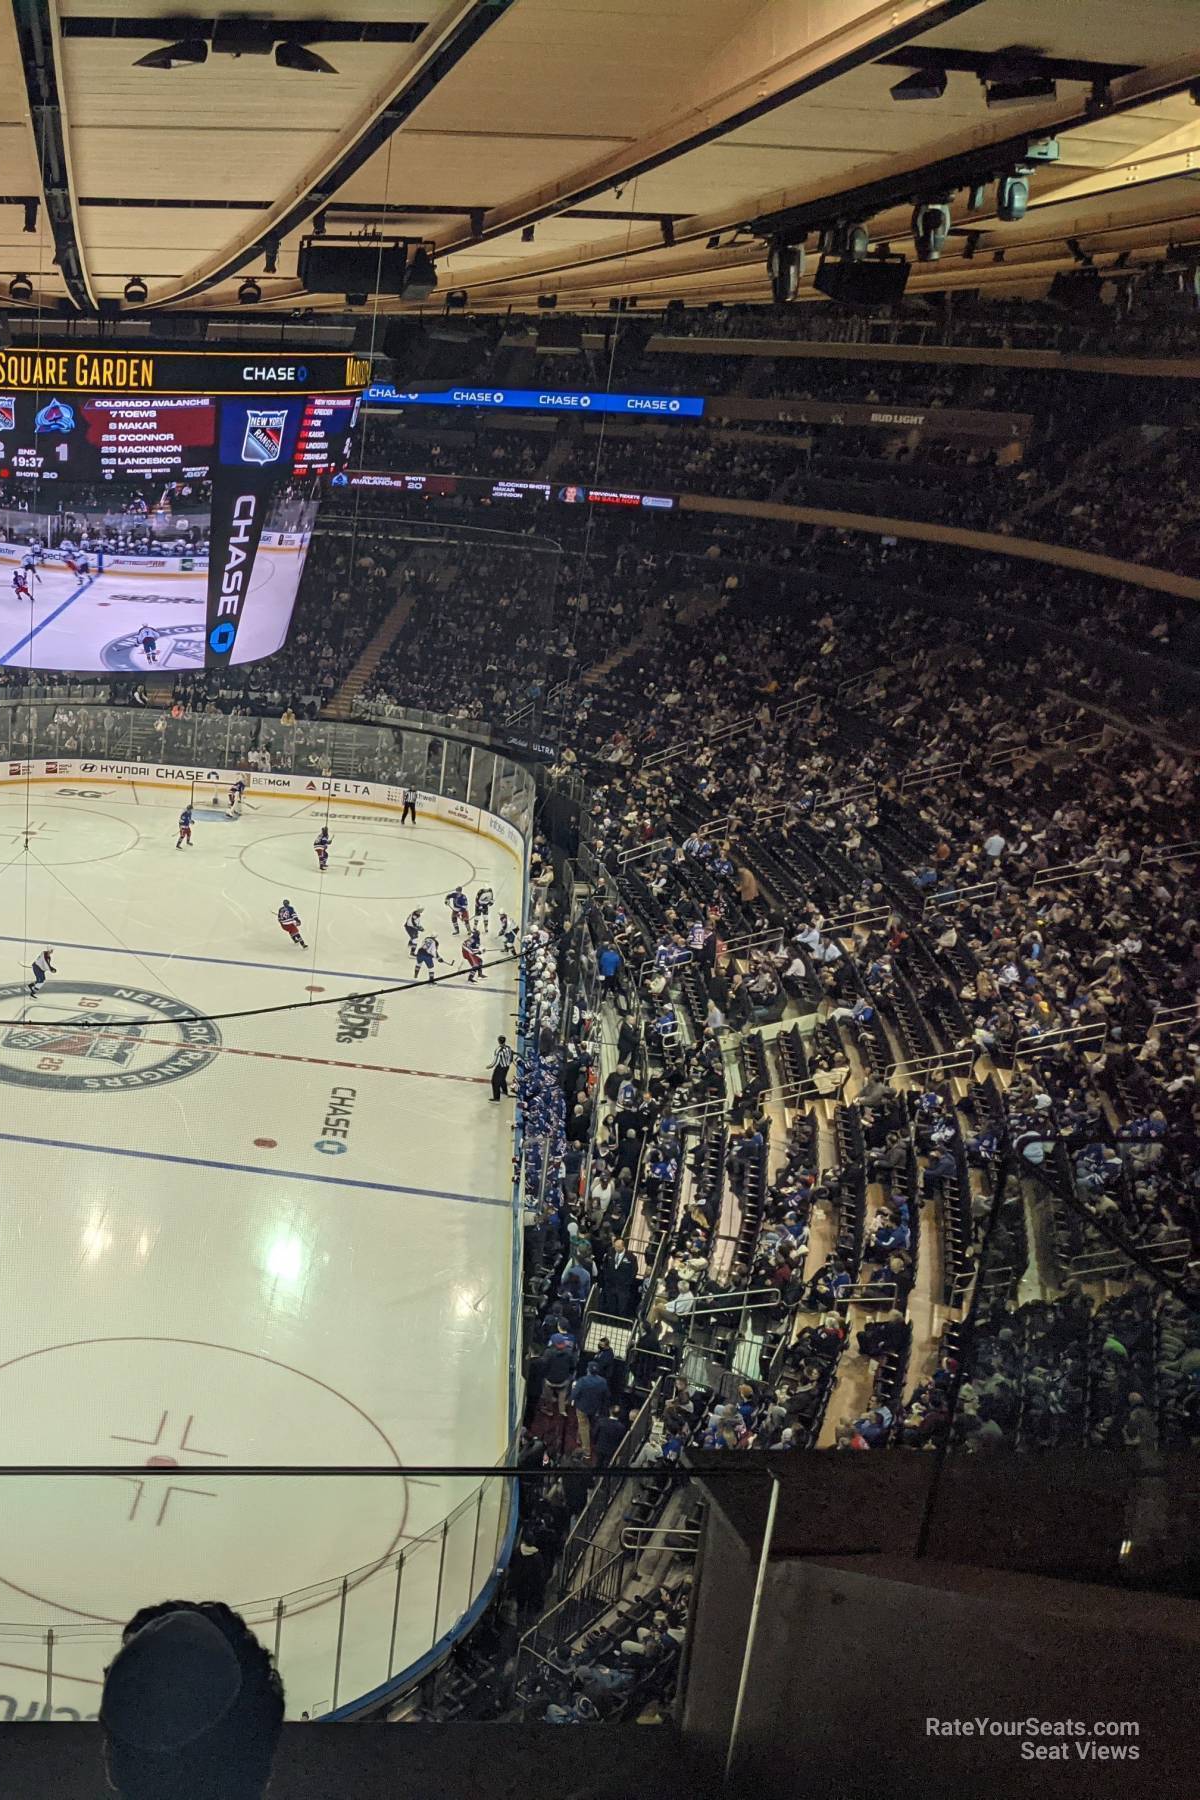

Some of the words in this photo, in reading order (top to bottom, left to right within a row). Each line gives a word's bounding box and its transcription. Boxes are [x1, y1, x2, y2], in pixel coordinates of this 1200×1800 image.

[75, 354, 154, 387] GARDEN
[243, 367, 295, 380] CHASE
[453, 391, 492, 402] CHASE
[539, 395, 578, 406] CHASE
[151, 398, 210, 407] AVALANCHE
[627, 399, 667, 410] CHASE
[118, 410, 157, 418] TOEWS
[871, 413, 892, 422] BUD
[894, 414, 925, 424] LIGHT
[118, 422, 157, 430] MAKAR
[251, 416, 268, 427] NEW
[119, 433, 174, 441] O'CONNOR
[253, 428, 279, 456] RANGERS
[55, 443, 68, 461] 1
[118, 445, 182, 453] MACKINNON
[11, 456, 44, 467] 19:37
[117, 457, 182, 465] LANDESKOG
[351, 478, 402, 487] AVALANCHE
[407, 482, 423, 490] 20
[217, 495, 256, 617] CHASE
[532, 743, 555, 756] ULTRA
[100, 765, 150, 777] HYUNDAI
[155, 769, 204, 781] CHASE
[252, 777, 290, 787] BETMGM
[56, 788, 102, 799] 5G
[321, 781, 371, 796] DELTA
[113, 989, 176, 1010] NEW
[82, 1052, 210, 1089] RANGERS
[321, 1086, 357, 1139] CHASE
